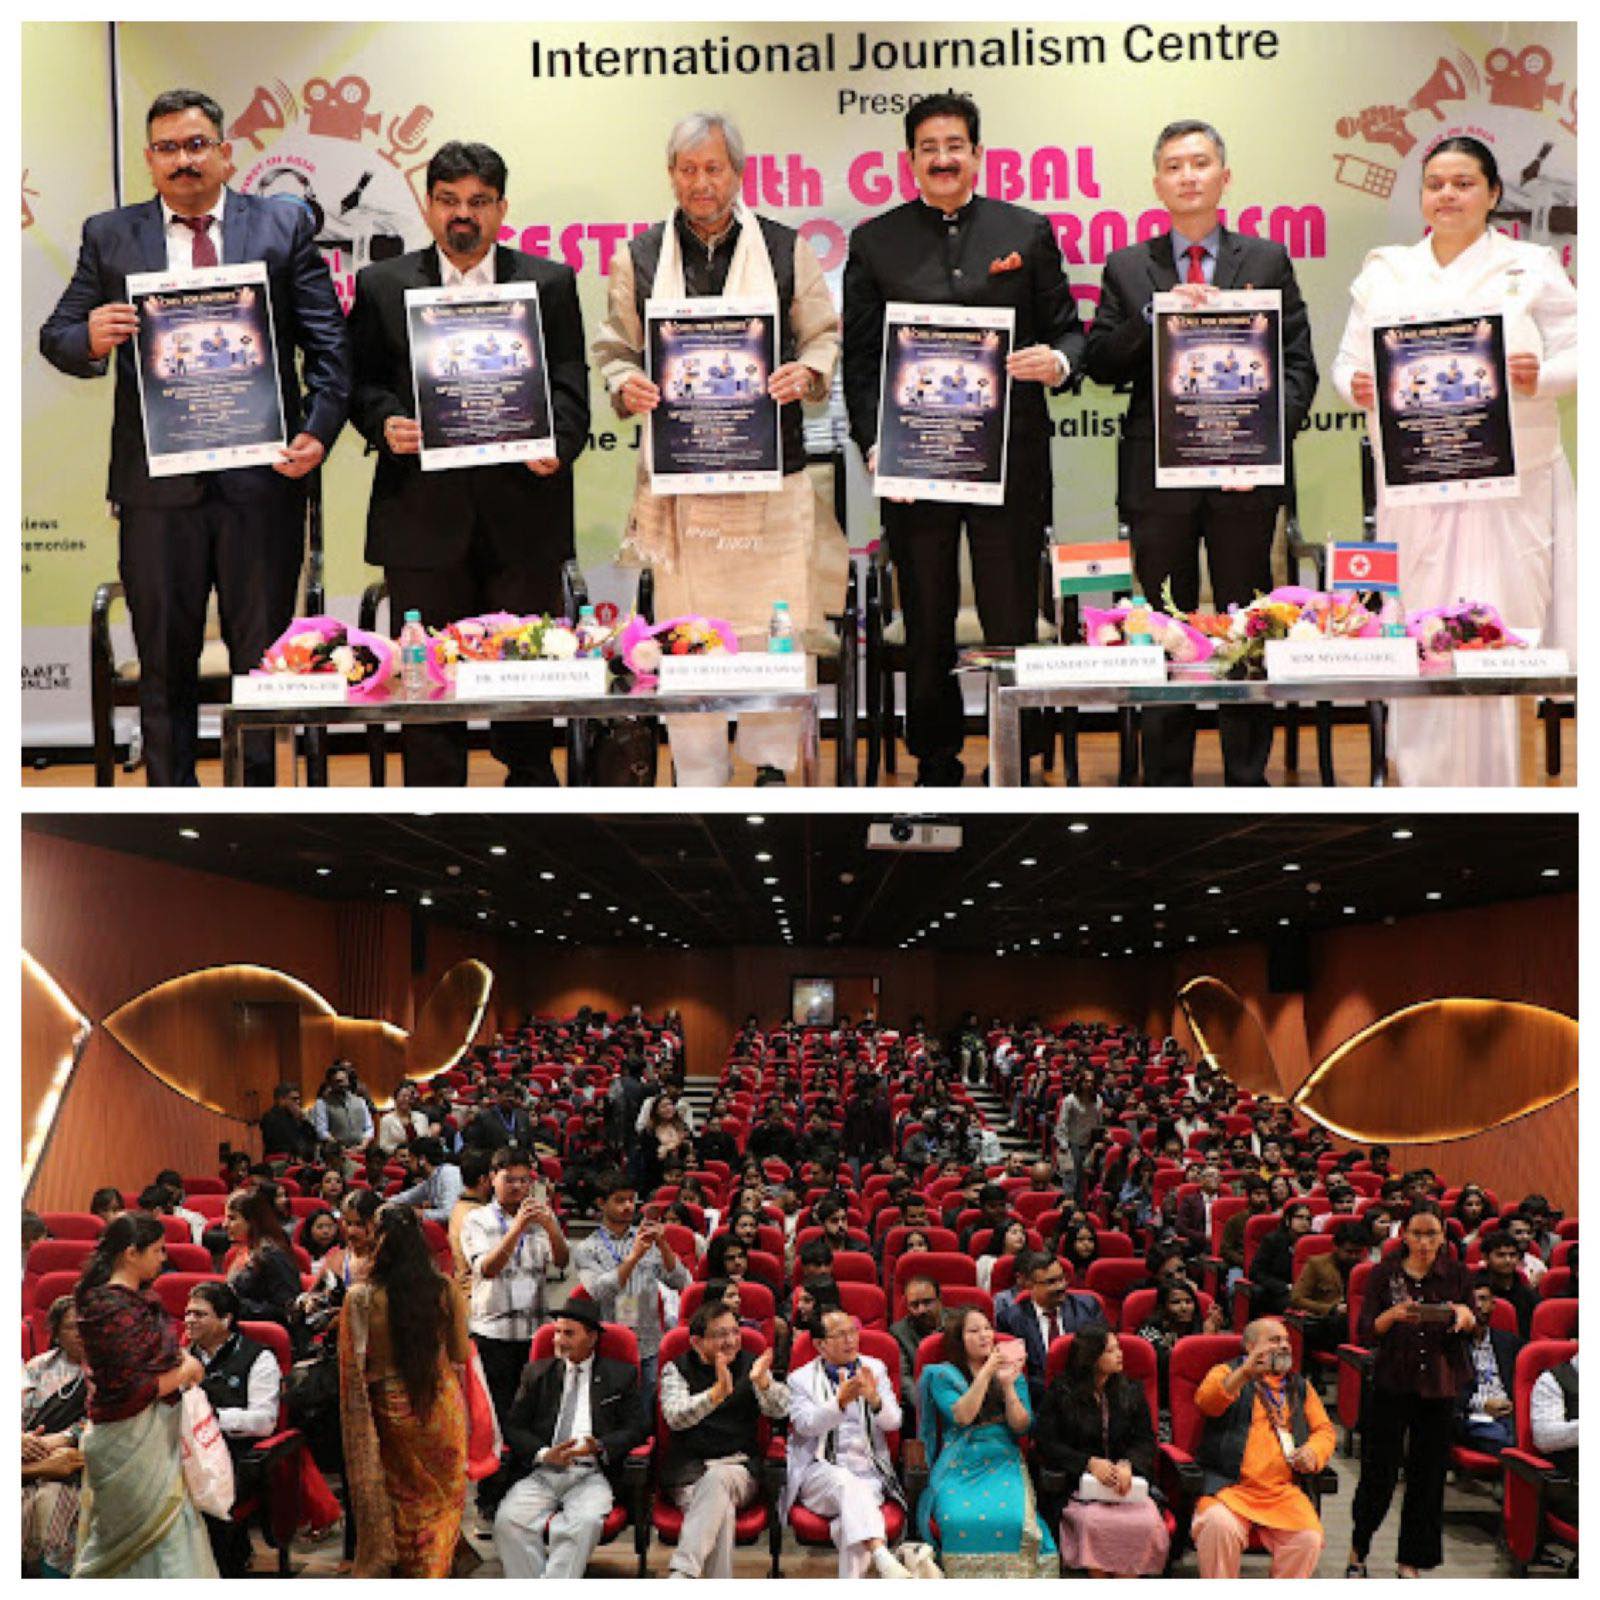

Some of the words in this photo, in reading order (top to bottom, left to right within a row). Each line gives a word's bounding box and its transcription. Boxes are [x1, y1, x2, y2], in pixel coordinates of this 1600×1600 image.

[531, 33, 835, 78] International
[849, 27, 1106, 71] Journalism
[1124, 23, 1279, 63] Centre
[848, 147, 1100, 207] GLBAL
